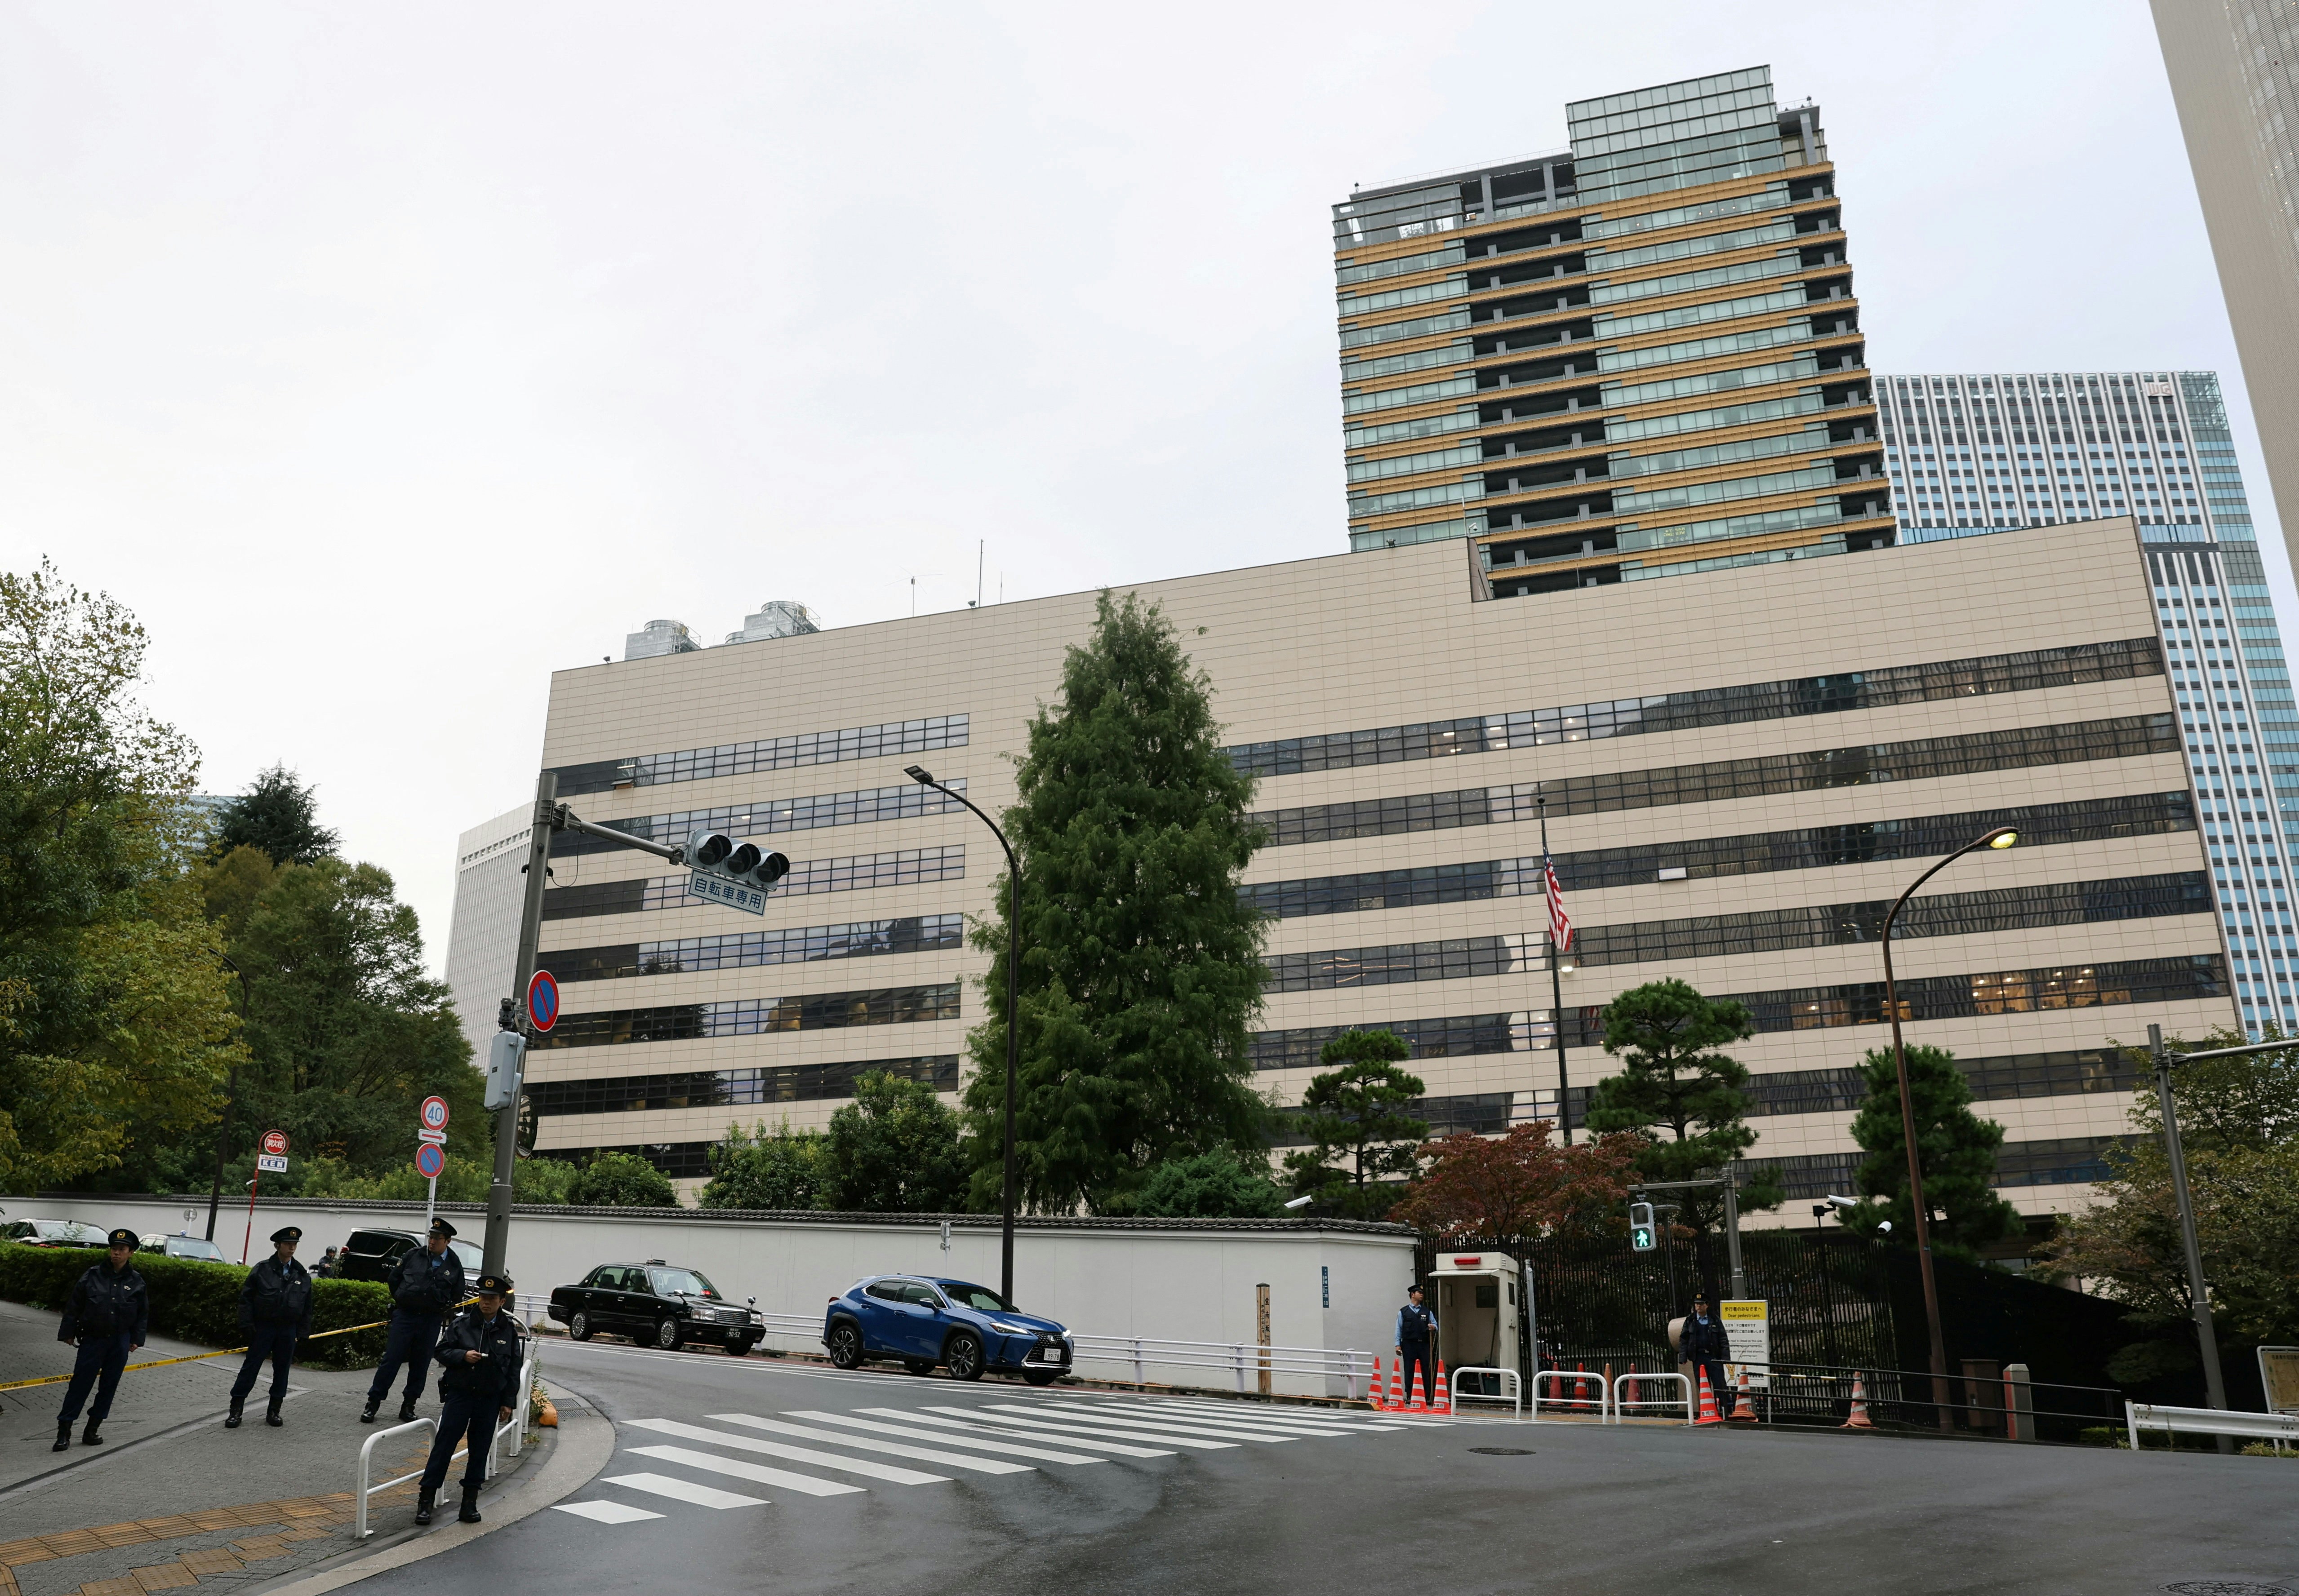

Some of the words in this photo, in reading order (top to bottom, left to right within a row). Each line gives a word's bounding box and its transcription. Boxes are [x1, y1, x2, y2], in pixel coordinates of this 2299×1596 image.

[695, 878, 762, 909] 自転車専用
[427, 1106, 443, 1122] 40
[267, 1139, 284, 1148] 消火栓
[262, 1160, 283, 1168] KEN
